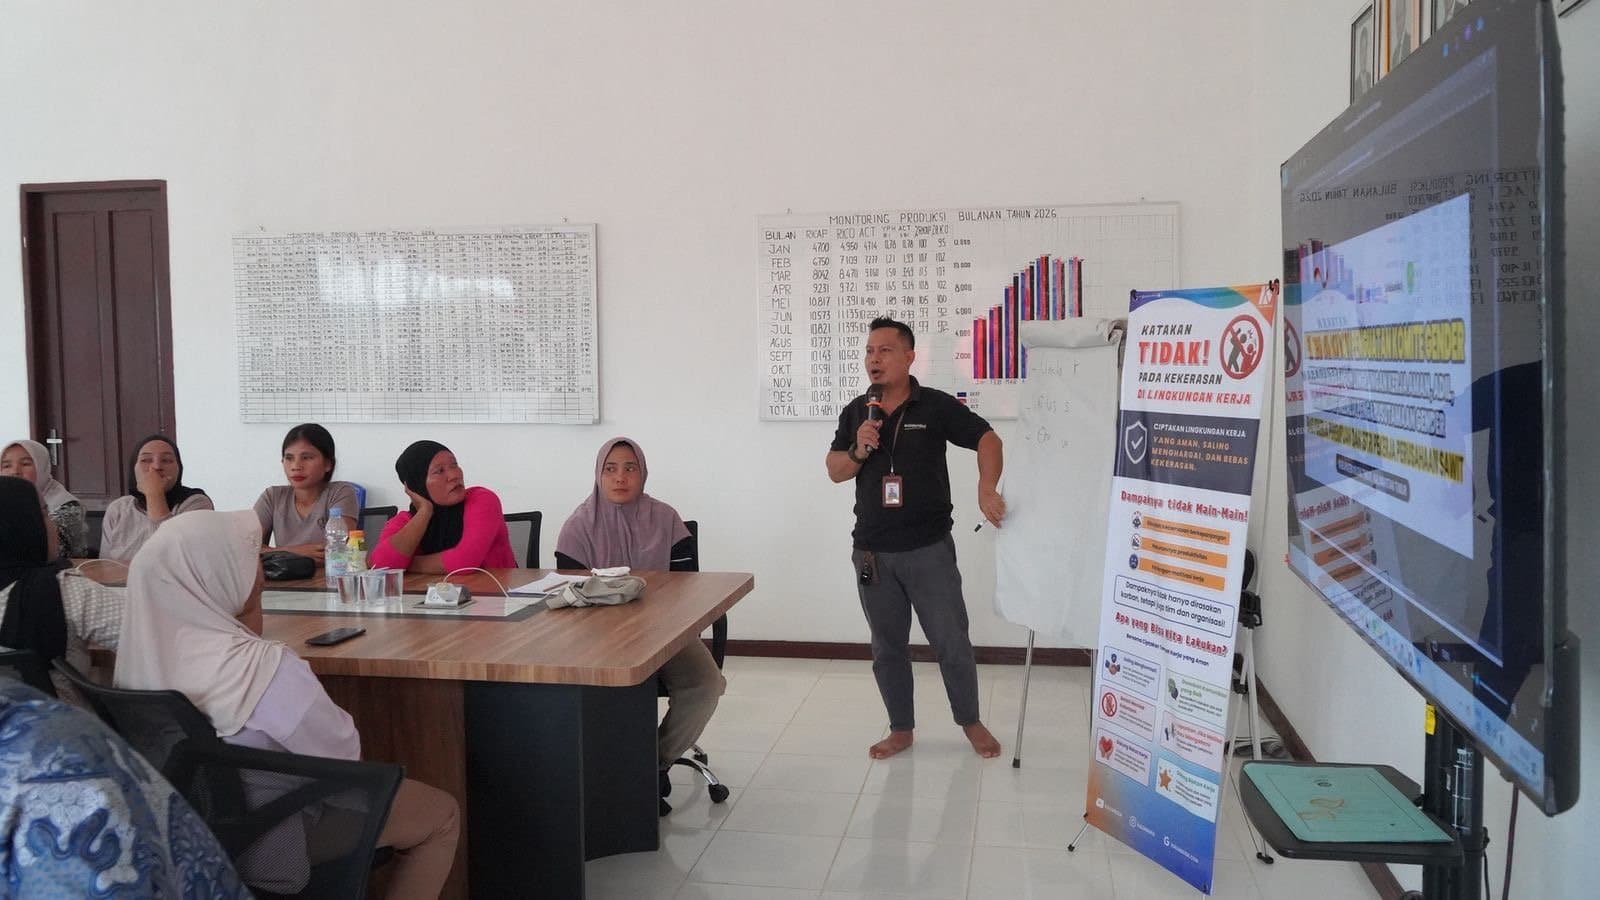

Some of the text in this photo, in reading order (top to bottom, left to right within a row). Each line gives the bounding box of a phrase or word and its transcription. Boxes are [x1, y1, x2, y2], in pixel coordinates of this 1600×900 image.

[829, 209, 1057, 225] MONITORING PRODUKSI BULANAN TAHUN 2026
[765, 230, 796, 240] BULAN
[859, 227, 876, 238] ACT
[768, 244, 791, 254] JAN
[772, 258, 792, 268] FEB
[771, 271, 791, 281] MAR
[772, 285, 792, 295] APR
[772, 298, 790, 309] MEI
[772, 312, 792, 321] JUN
[772, 325, 792, 334] JUL
[1141, 324, 1192, 336] KATAKAN
[770, 339, 792, 348] AGUS
[1426, 317, 1465, 364] GENDER
[770, 351, 792, 361] SEPT
[1138, 340, 1210, 366] TIDAK!
[771, 365, 791, 374] OKT
[773, 379, 792, 388] NOV
[1138, 372, 1223, 385] PADA KEKERASAN
[773, 391, 793, 402] DES
[1137, 389, 1251, 405] DI LINGKUNGAN KERJA
[769, 405, 798, 416] TOTAL
[1153, 423, 1247, 438] CIPTAKAN LINGKUNGAN KERJA
[1153, 436, 1229, 450] YANG AMAN, SALING
[1152, 448, 1248, 465] MENGHARGAI, DAN BEBAS
[1151, 459, 1196, 471] KEKERASAN.
[1168, 499, 1193, 512] tidak
[1196, 504, 1248, 522] Main-Main!
[1125, 581, 1157, 597] Dampaknya
[1168, 594, 1190, 606] hanya
[1190, 600, 1222, 614] dirasakan
[1121, 592, 1140, 604] korban,
[1140, 597, 1157, 609] tetapi
[1165, 605, 1176, 614] tim
[1176, 608, 1190, 617] dan
[1191, 613, 1226, 627] organisasi!
[1115, 612, 1130, 625] Apa
[1131, 617, 1149, 633] yang
[1185, 635, 1229, 658] Lakukan?
[1182, 654, 1195, 664] yang
